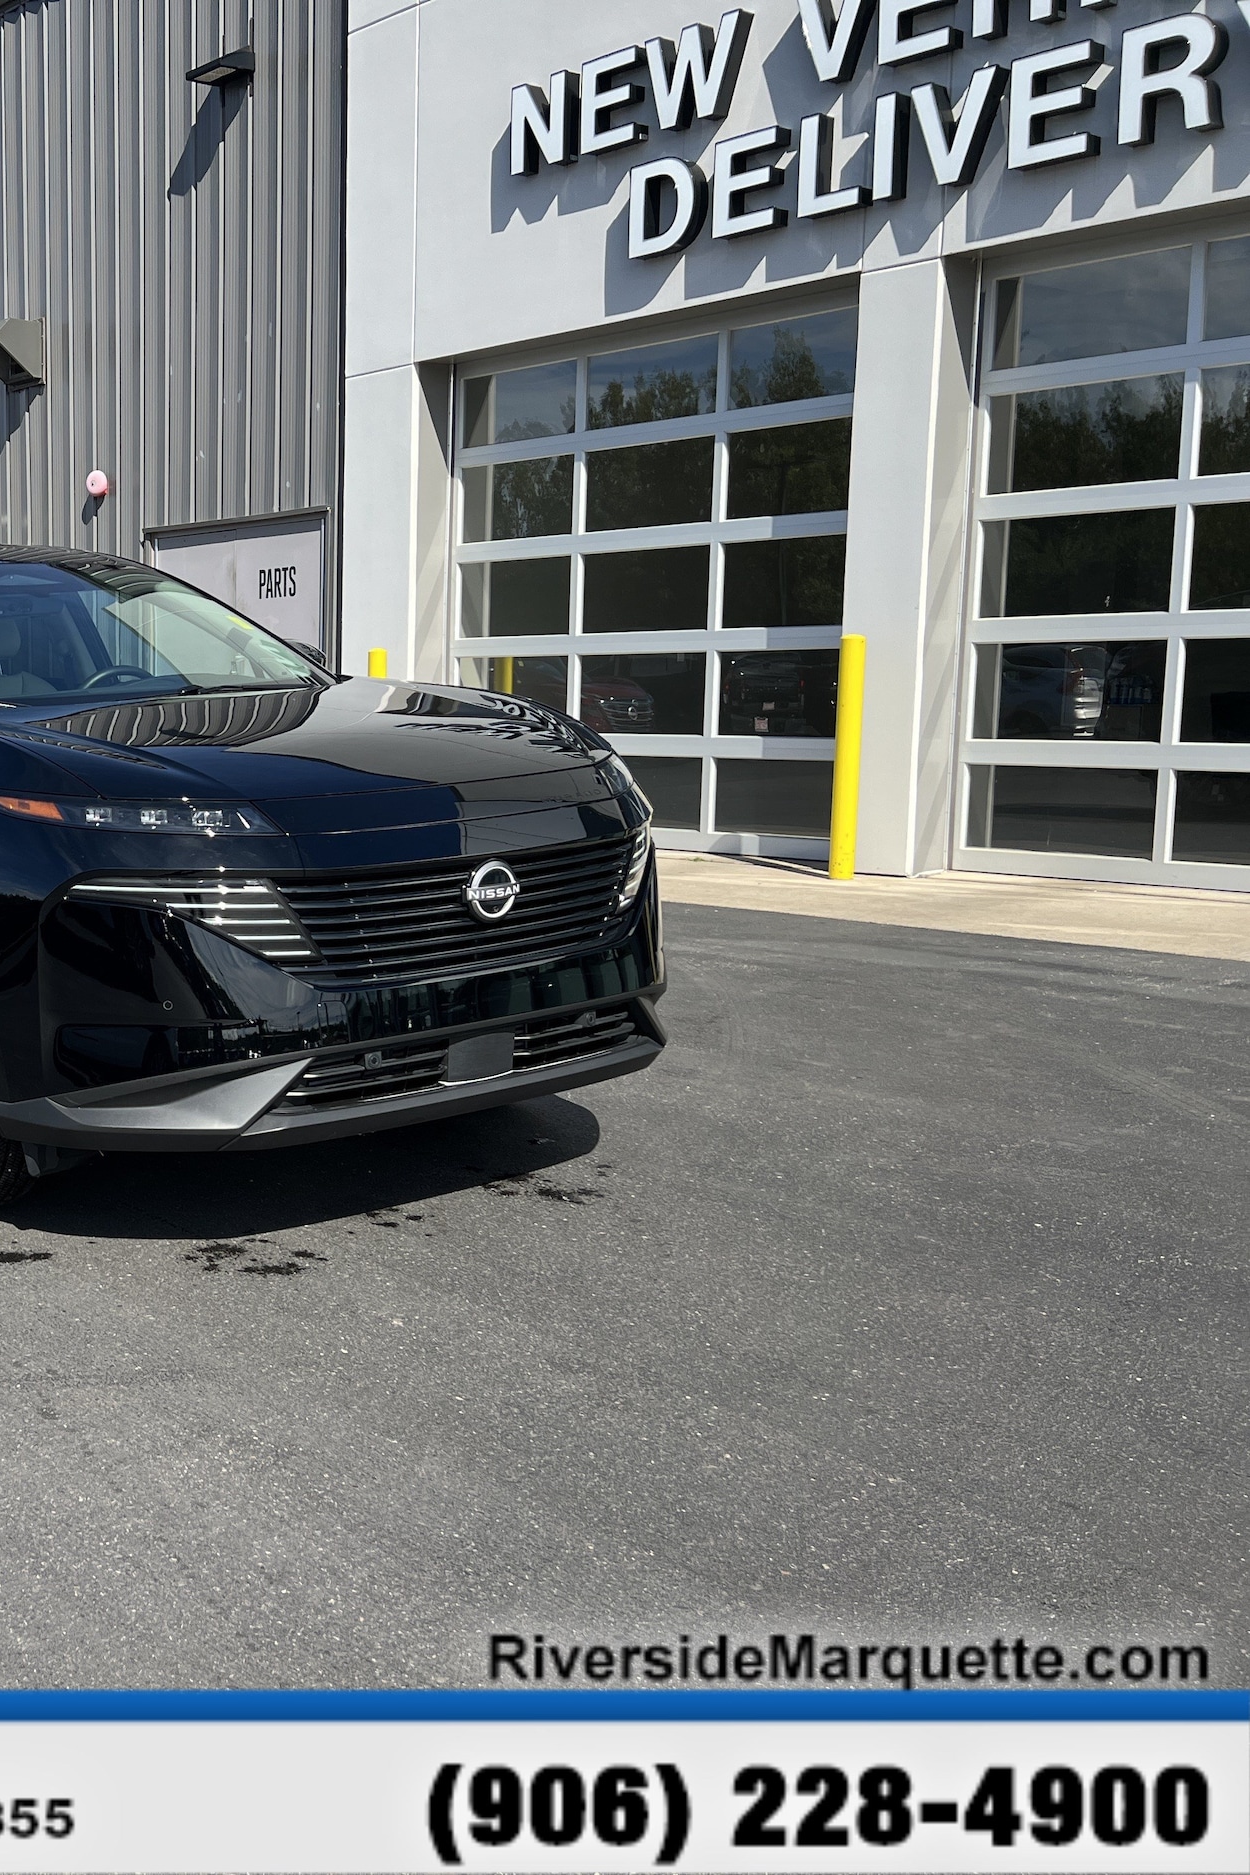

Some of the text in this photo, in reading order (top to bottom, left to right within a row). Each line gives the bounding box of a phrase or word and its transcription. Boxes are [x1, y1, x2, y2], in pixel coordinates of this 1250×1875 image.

[508, 8, 755, 177] NEW
[627, 0, 1250, 261] DELIVER
[258, 565, 297, 600] PARTS
[468, 883, 520, 900] NISSAN
